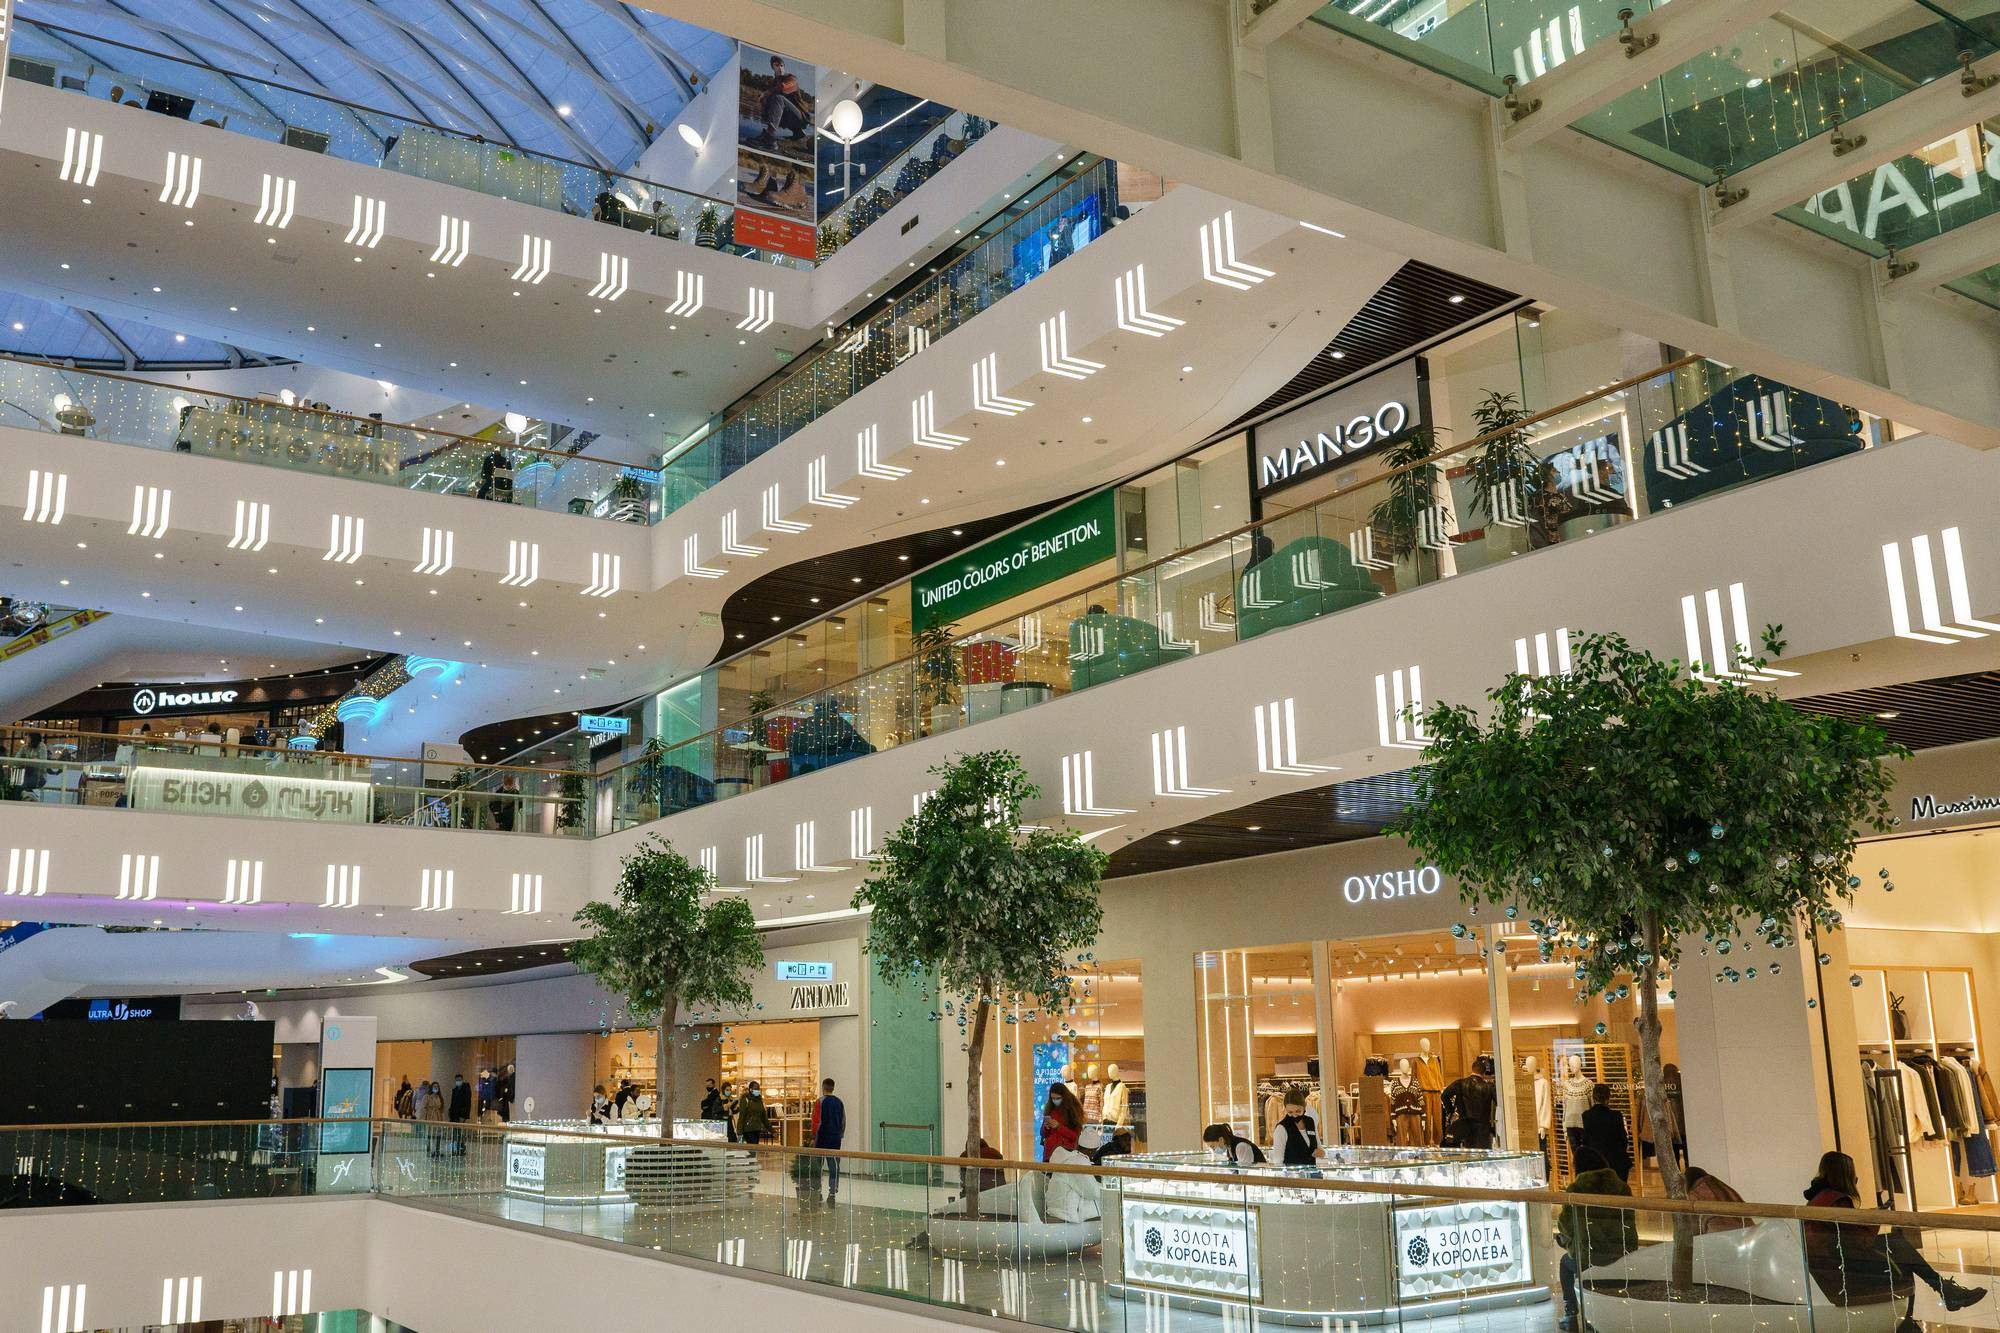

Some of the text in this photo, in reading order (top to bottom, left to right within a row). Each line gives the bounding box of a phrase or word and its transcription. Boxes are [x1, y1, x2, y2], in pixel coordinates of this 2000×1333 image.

[1262, 401, 1408, 486] MANGO
[921, 579, 962, 608] UNITED
[963, 557, 1010, 590] COLORS
[1011, 549, 1029, 570] OF
[159, 690, 238, 706] house
[1912, 795, 2000, 820] Massim
[1344, 866, 1440, 903] OYSHO
[88, 1010, 113, 1018] ULTRA
[129, 1009, 152, 1017] SHOP
[1173, 1229, 1230, 1248] ЗОЛОТА
[1439, 1227, 1502, 1247] ЗОЛОТА
[1166, 1246, 1238, 1268] КОРОЛЕВА
[1432, 1245, 1509, 1267] КОРОЛЕВА
